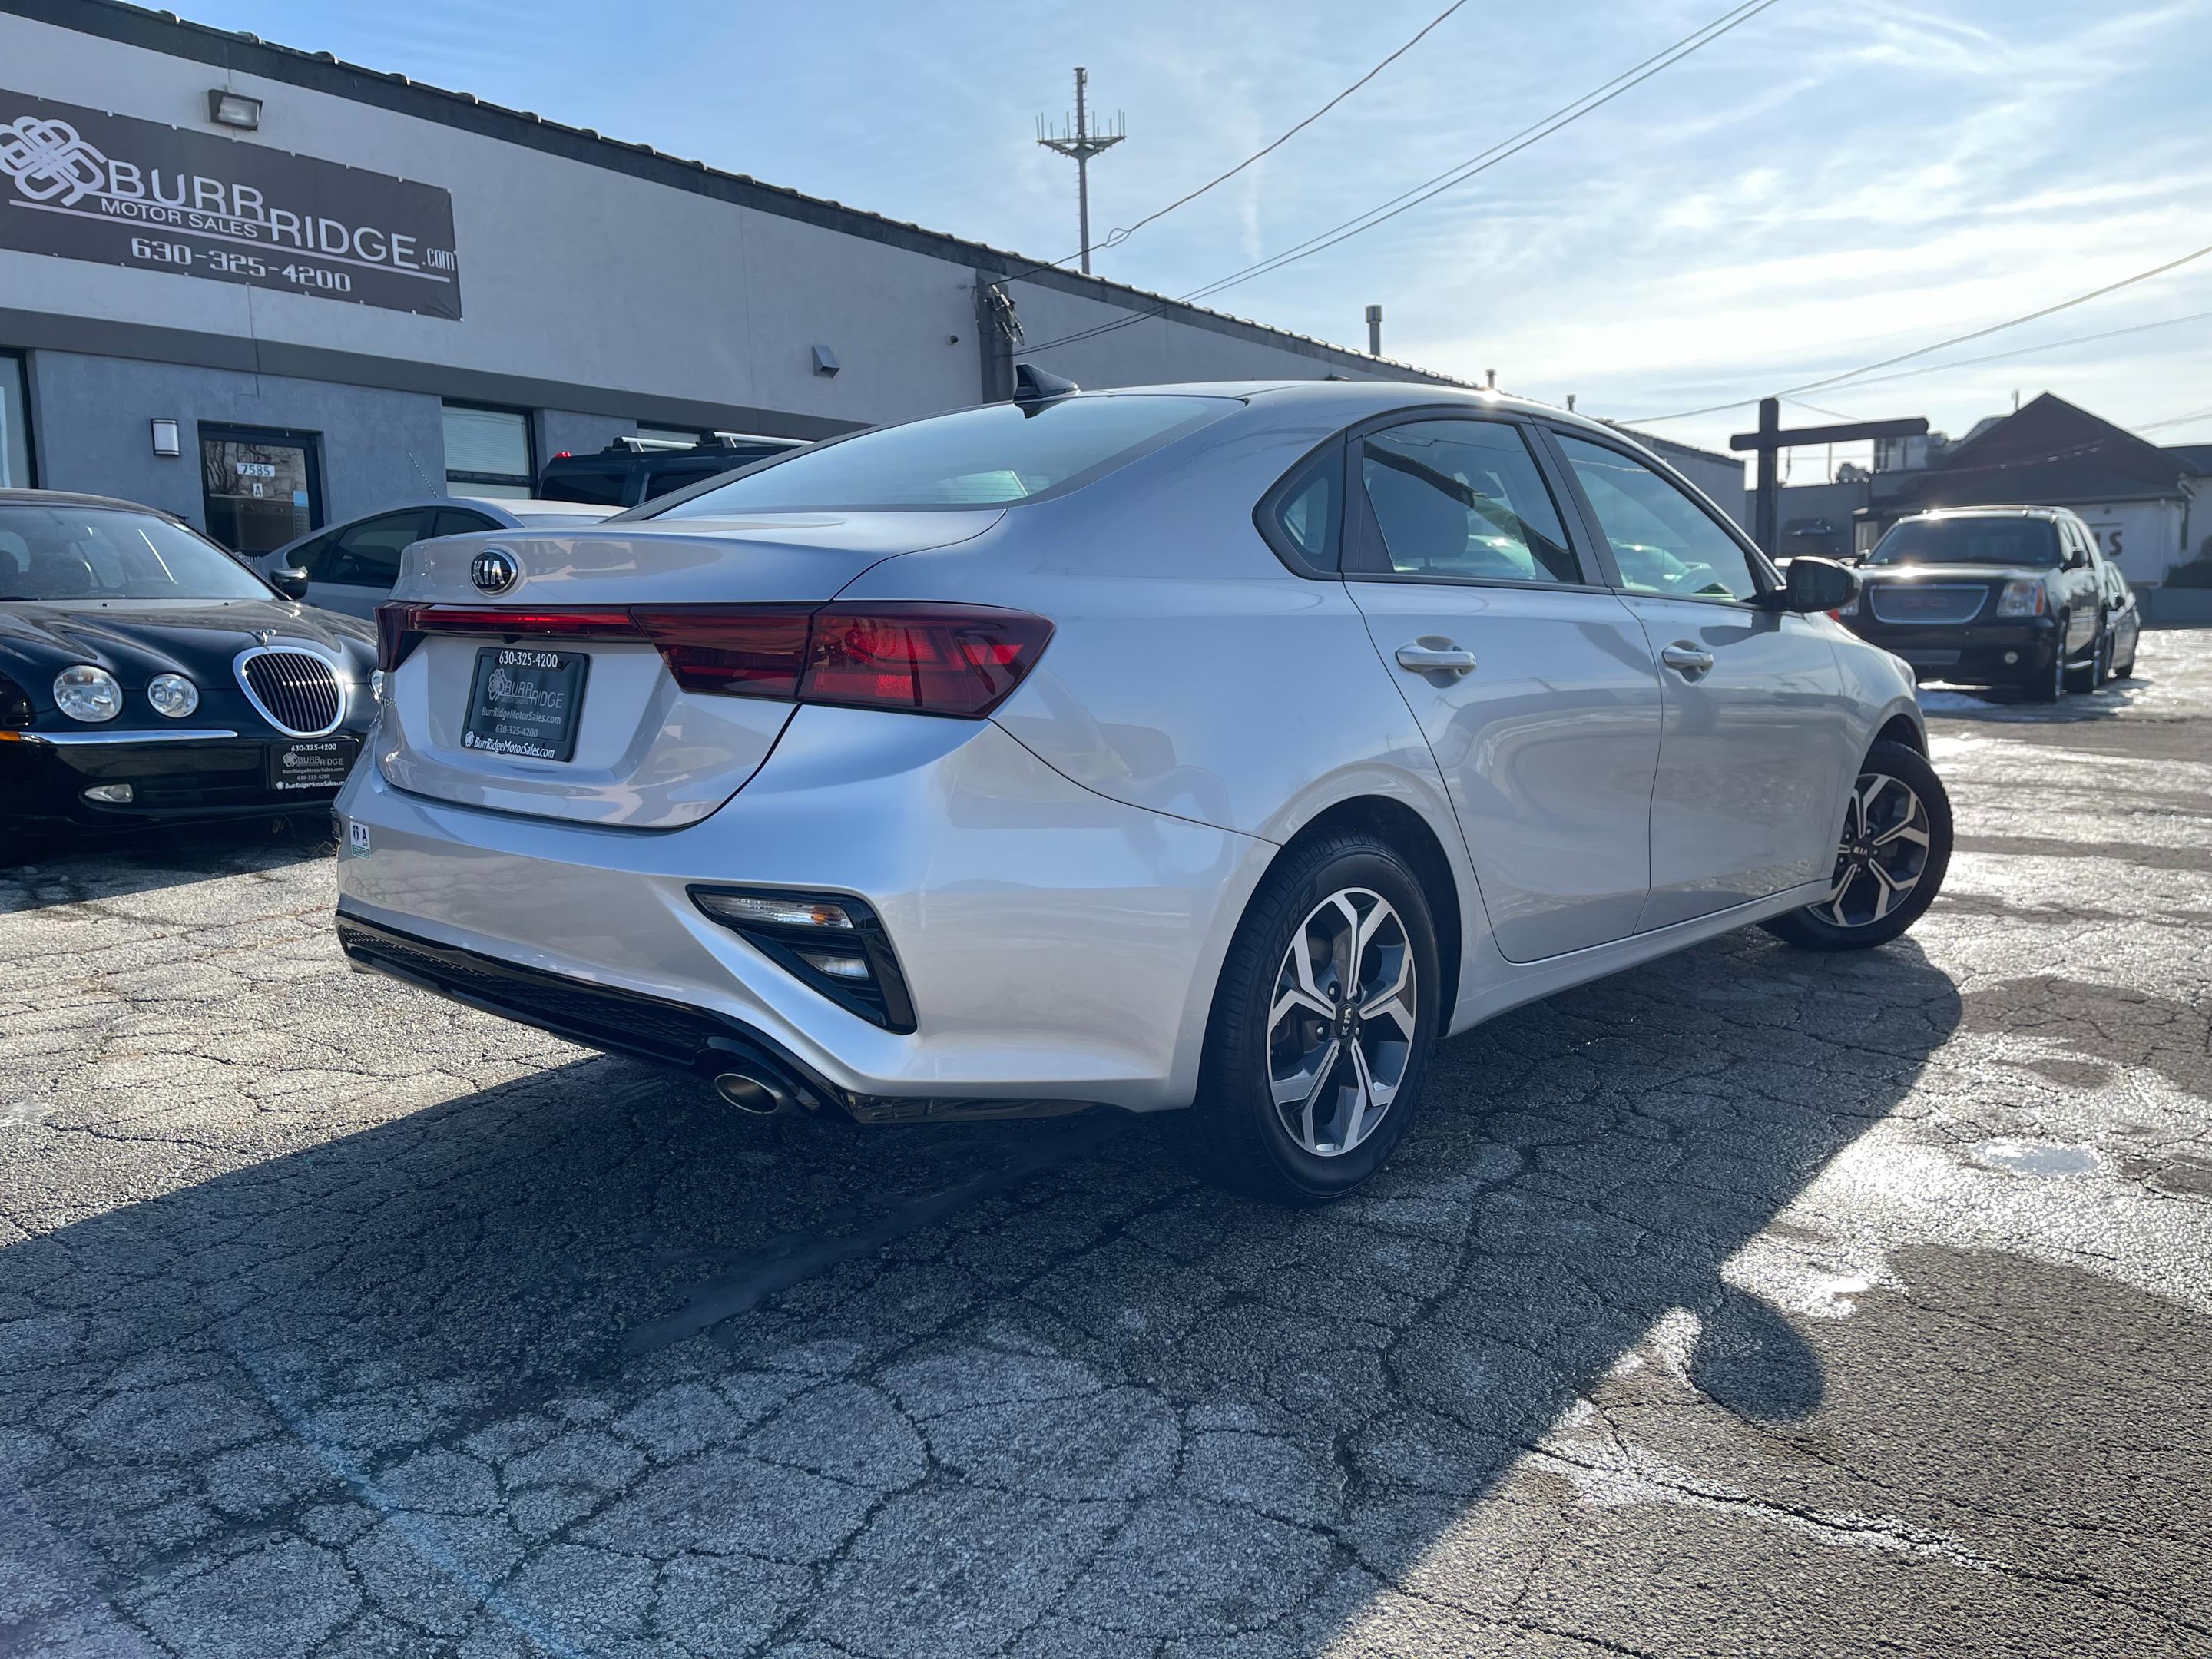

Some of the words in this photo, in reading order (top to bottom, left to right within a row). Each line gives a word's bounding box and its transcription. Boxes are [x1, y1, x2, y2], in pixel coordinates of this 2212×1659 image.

[101, 198, 182, 224] MOTOR
[188, 214, 258, 239] SALES
[131, 237, 351, 292] 630-325-4200
[241, 464, 270, 476] 7585
[255, 485, 262, 497] A
[472, 560, 505, 584] KIA
[499, 651, 558, 668] 630-325-4200
[481, 706, 562, 725] BurrRidgeMotorSales.com
[495, 724, 538, 738] 630-325-4200
[290, 743, 337, 752] 630-325-4200
[474, 736, 555, 759] BurrRidgeMotorSales.com
[1853, 845, 1868, 856] KIA
[1340, 1007, 1353, 1037] KIA
